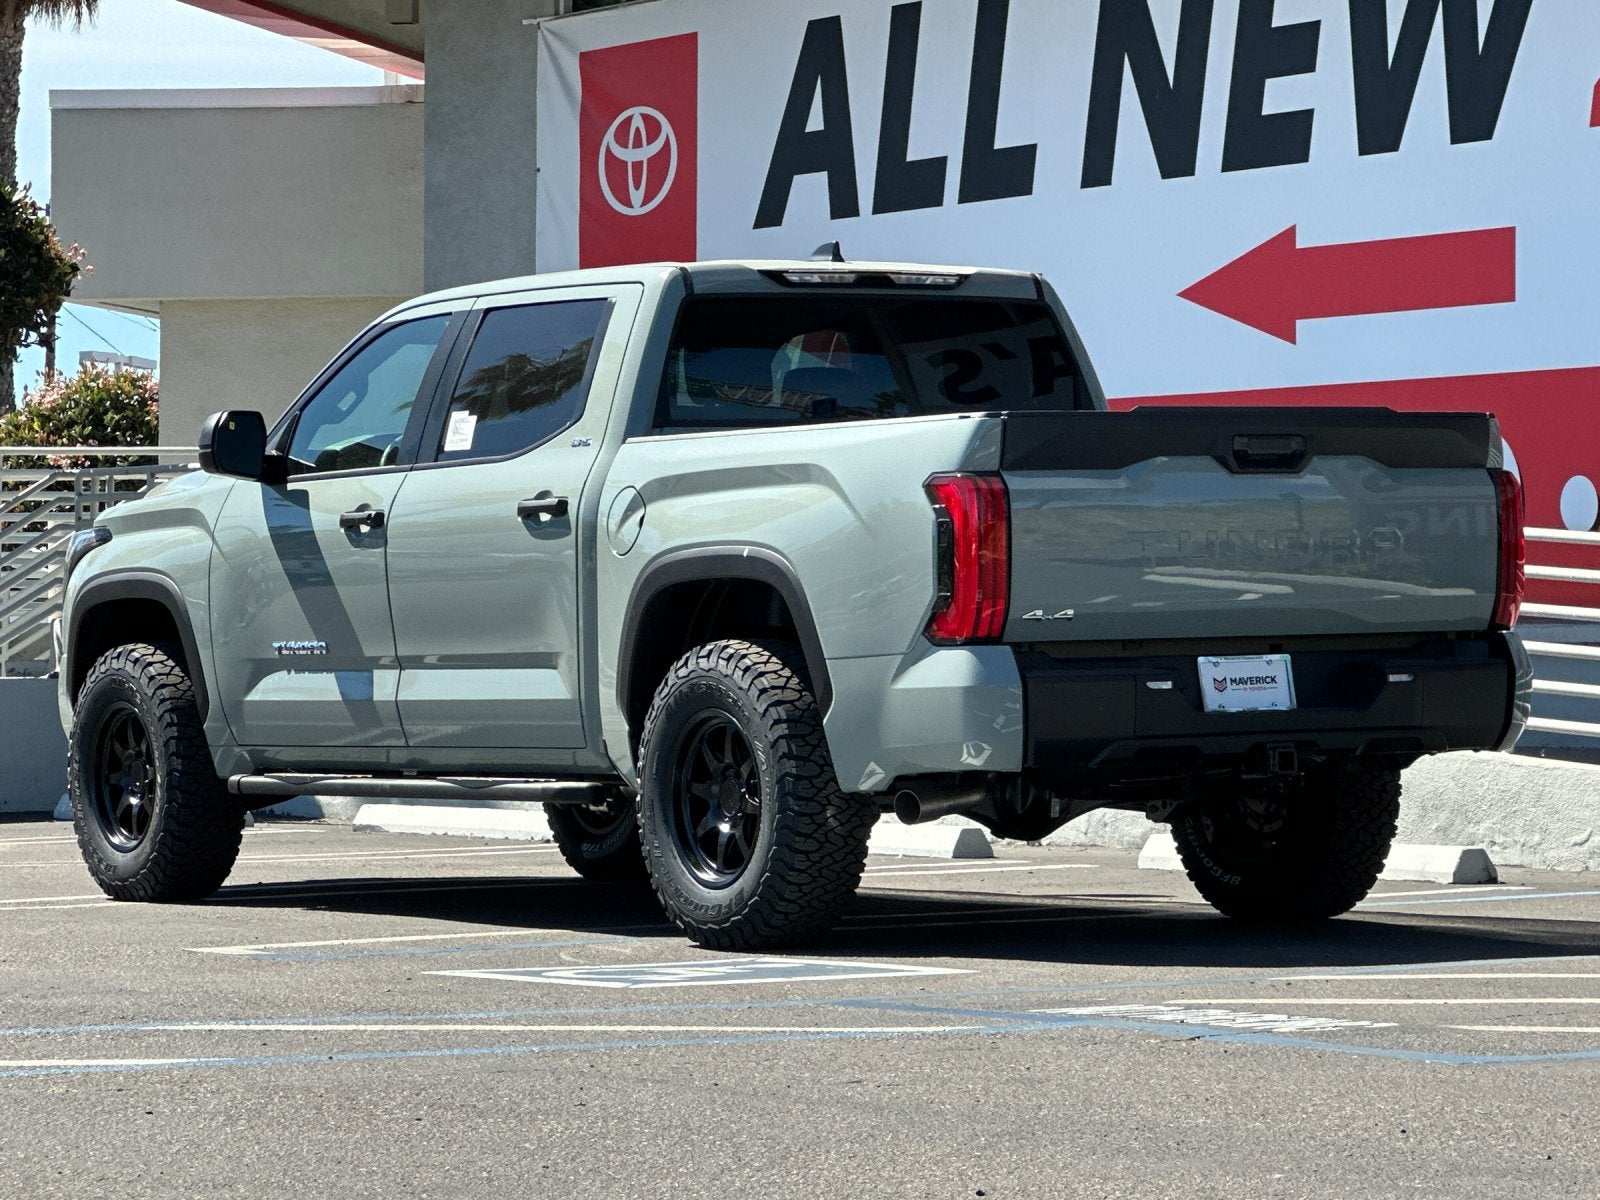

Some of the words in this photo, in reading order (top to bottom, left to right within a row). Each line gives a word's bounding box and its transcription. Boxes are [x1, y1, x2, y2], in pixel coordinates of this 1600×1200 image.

[753, 0, 1037, 229] ALL
[1081, 0, 1533, 189] NEW
[1229, 675, 1278, 686] MAVERICK
